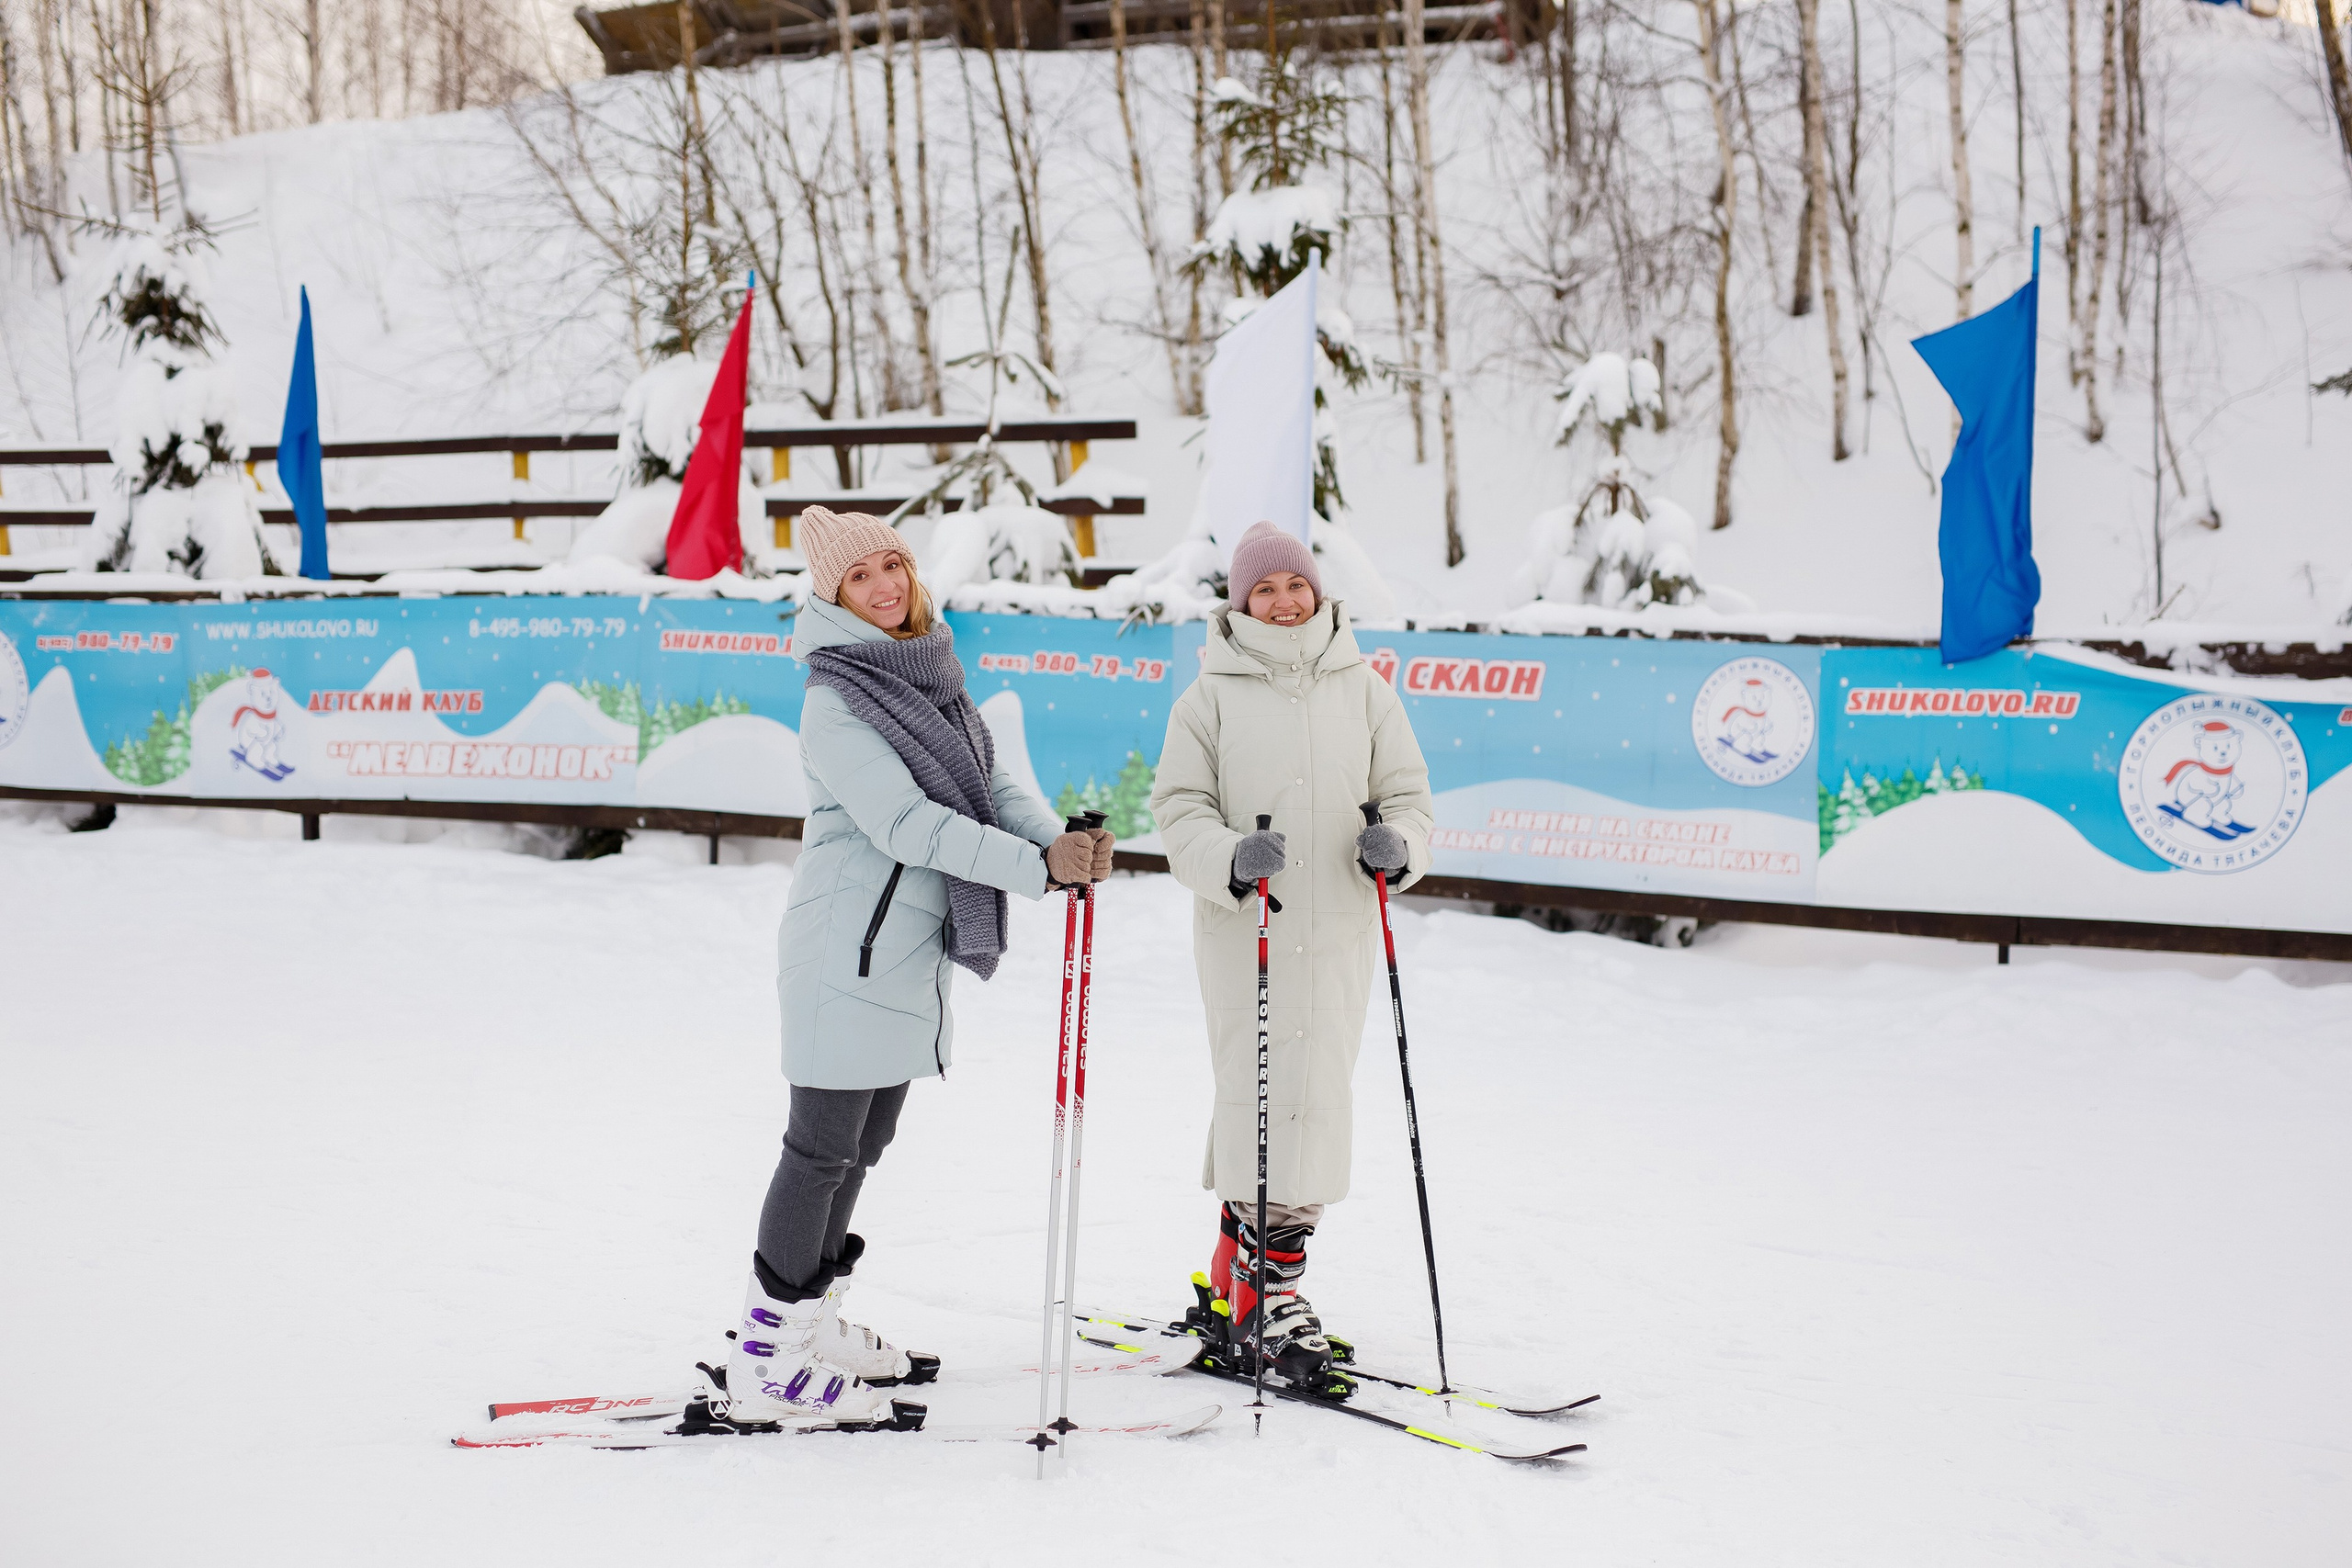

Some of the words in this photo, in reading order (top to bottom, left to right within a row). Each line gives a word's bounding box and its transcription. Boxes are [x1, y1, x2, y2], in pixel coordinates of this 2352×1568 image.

[205, 618, 379, 640] WWW.SHUKOLOVO.RU
[662, 632, 793, 653] SHUKOLOVO.R
[1034, 651, 1165, 681] 980-79-79
[1408, 661, 1541, 696] СКЛОН
[307, 687, 413, 713] ДЕТСКИЙ
[422, 691, 483, 713] КЛУБ
[1847, 691, 2078, 716] SHUKOLOVO.RU
[2274, 728, 2302, 779] КЛУБ
[1258, 987, 1268, 1145] KOMPERDELL
[768, 1393, 805, 1408] FISCHER
